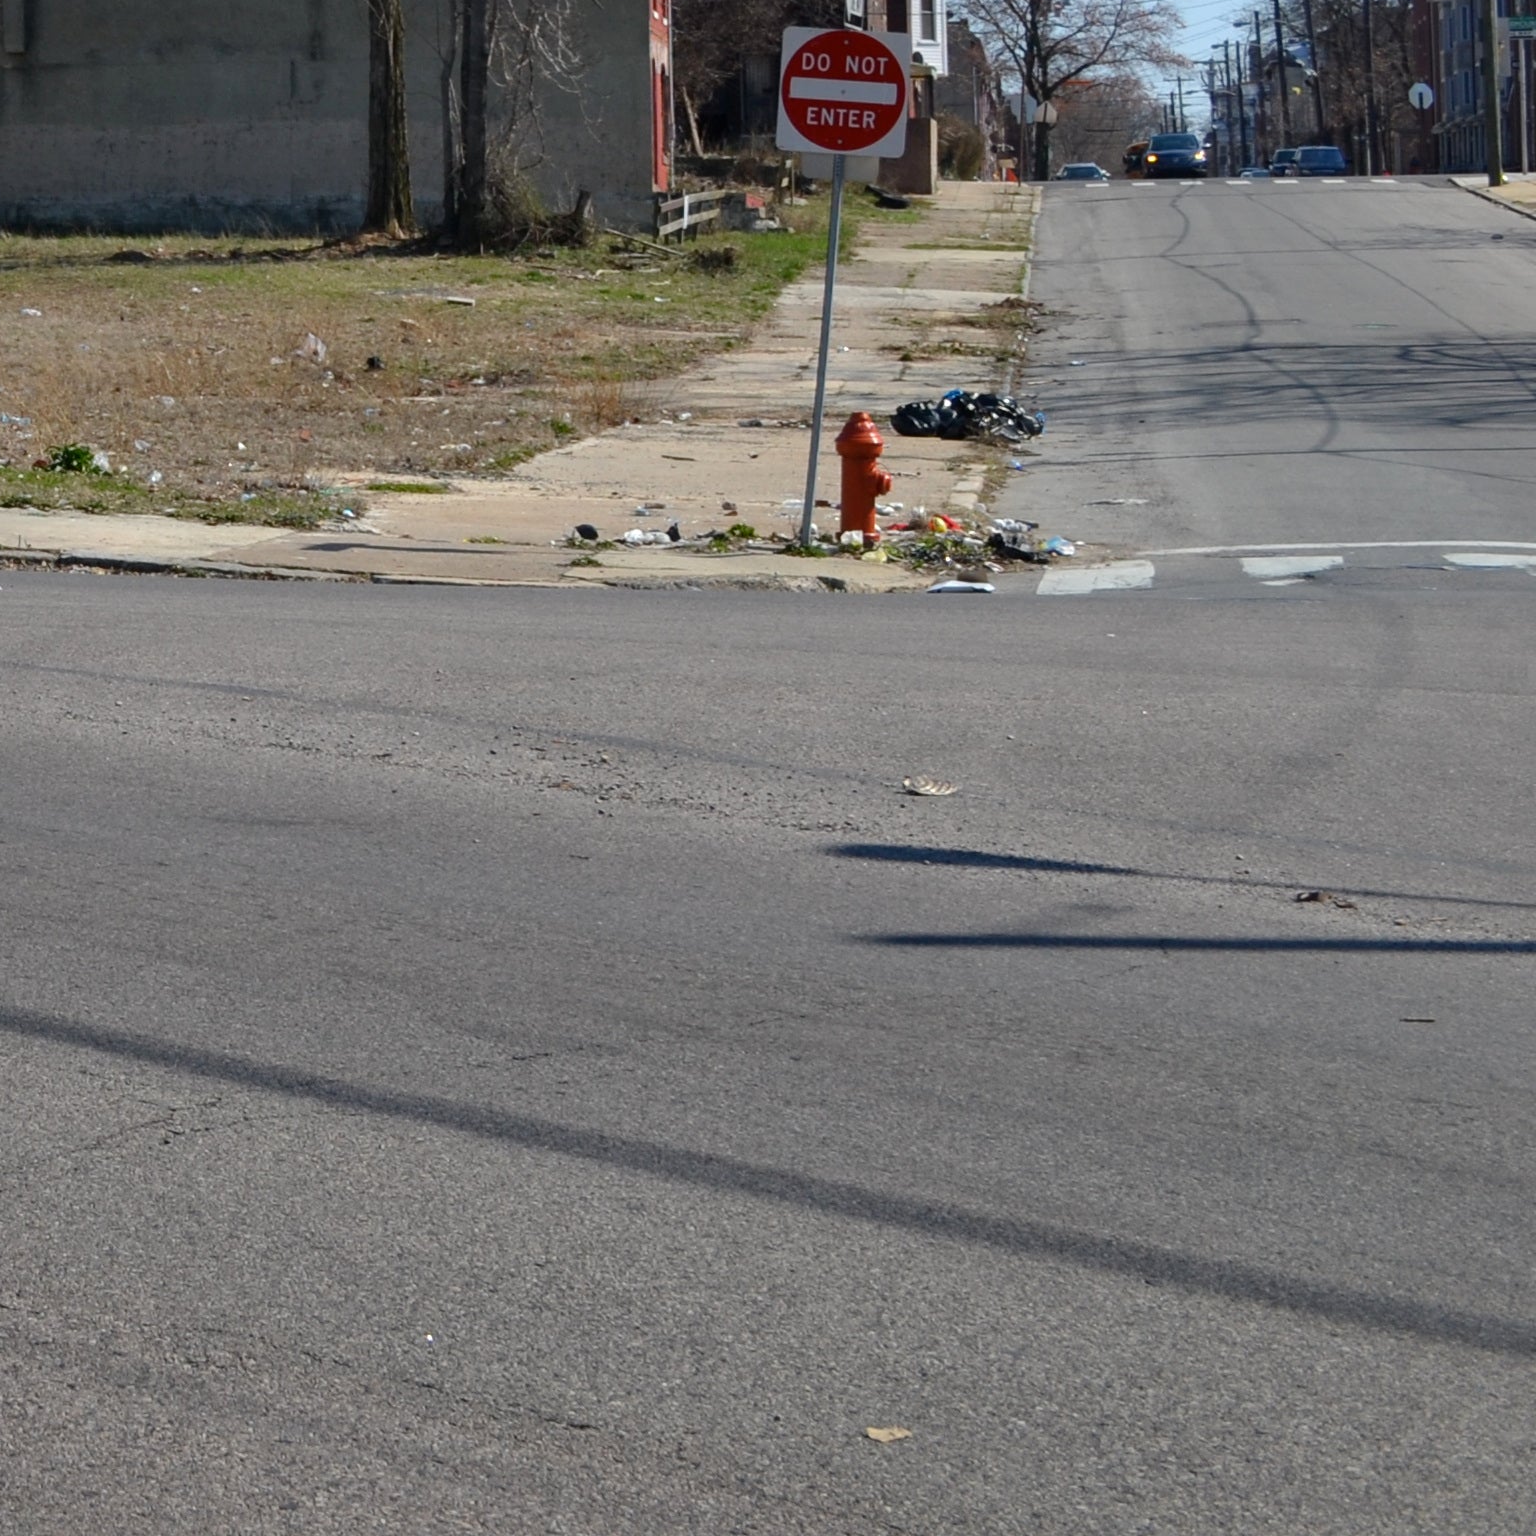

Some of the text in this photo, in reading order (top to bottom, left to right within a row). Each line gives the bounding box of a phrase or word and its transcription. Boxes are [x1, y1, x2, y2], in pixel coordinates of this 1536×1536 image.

[801, 52, 889, 76] DO NOT
[806, 106, 875, 129] ENTER
